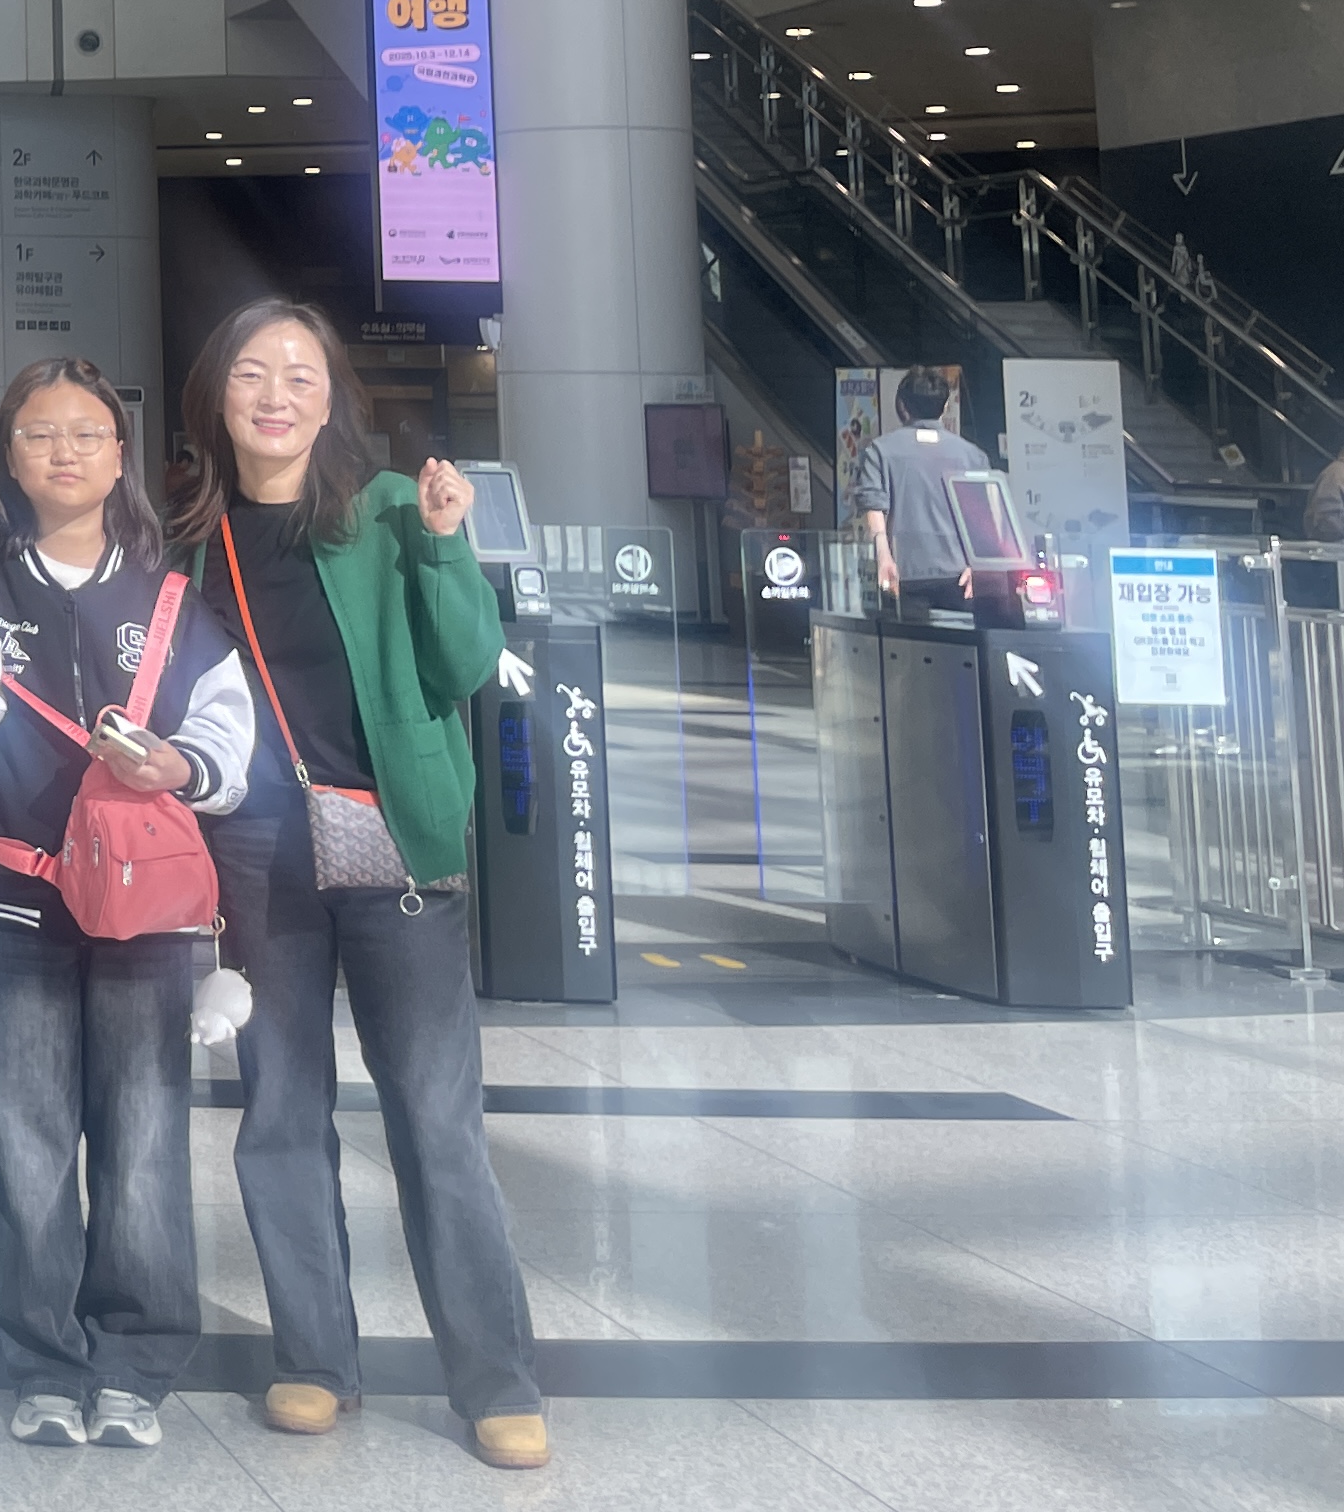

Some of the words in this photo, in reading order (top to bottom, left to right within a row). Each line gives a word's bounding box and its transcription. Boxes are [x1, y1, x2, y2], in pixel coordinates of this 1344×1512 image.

[13, 148, 31, 166] 2F
[16, 243, 34, 262] 1F
[1118, 582, 1172, 602] 재입장
[1178, 583, 1212, 604] 가능
[575, 894, 598, 956] 출입구
[1092, 901, 1113, 962] 출입구
